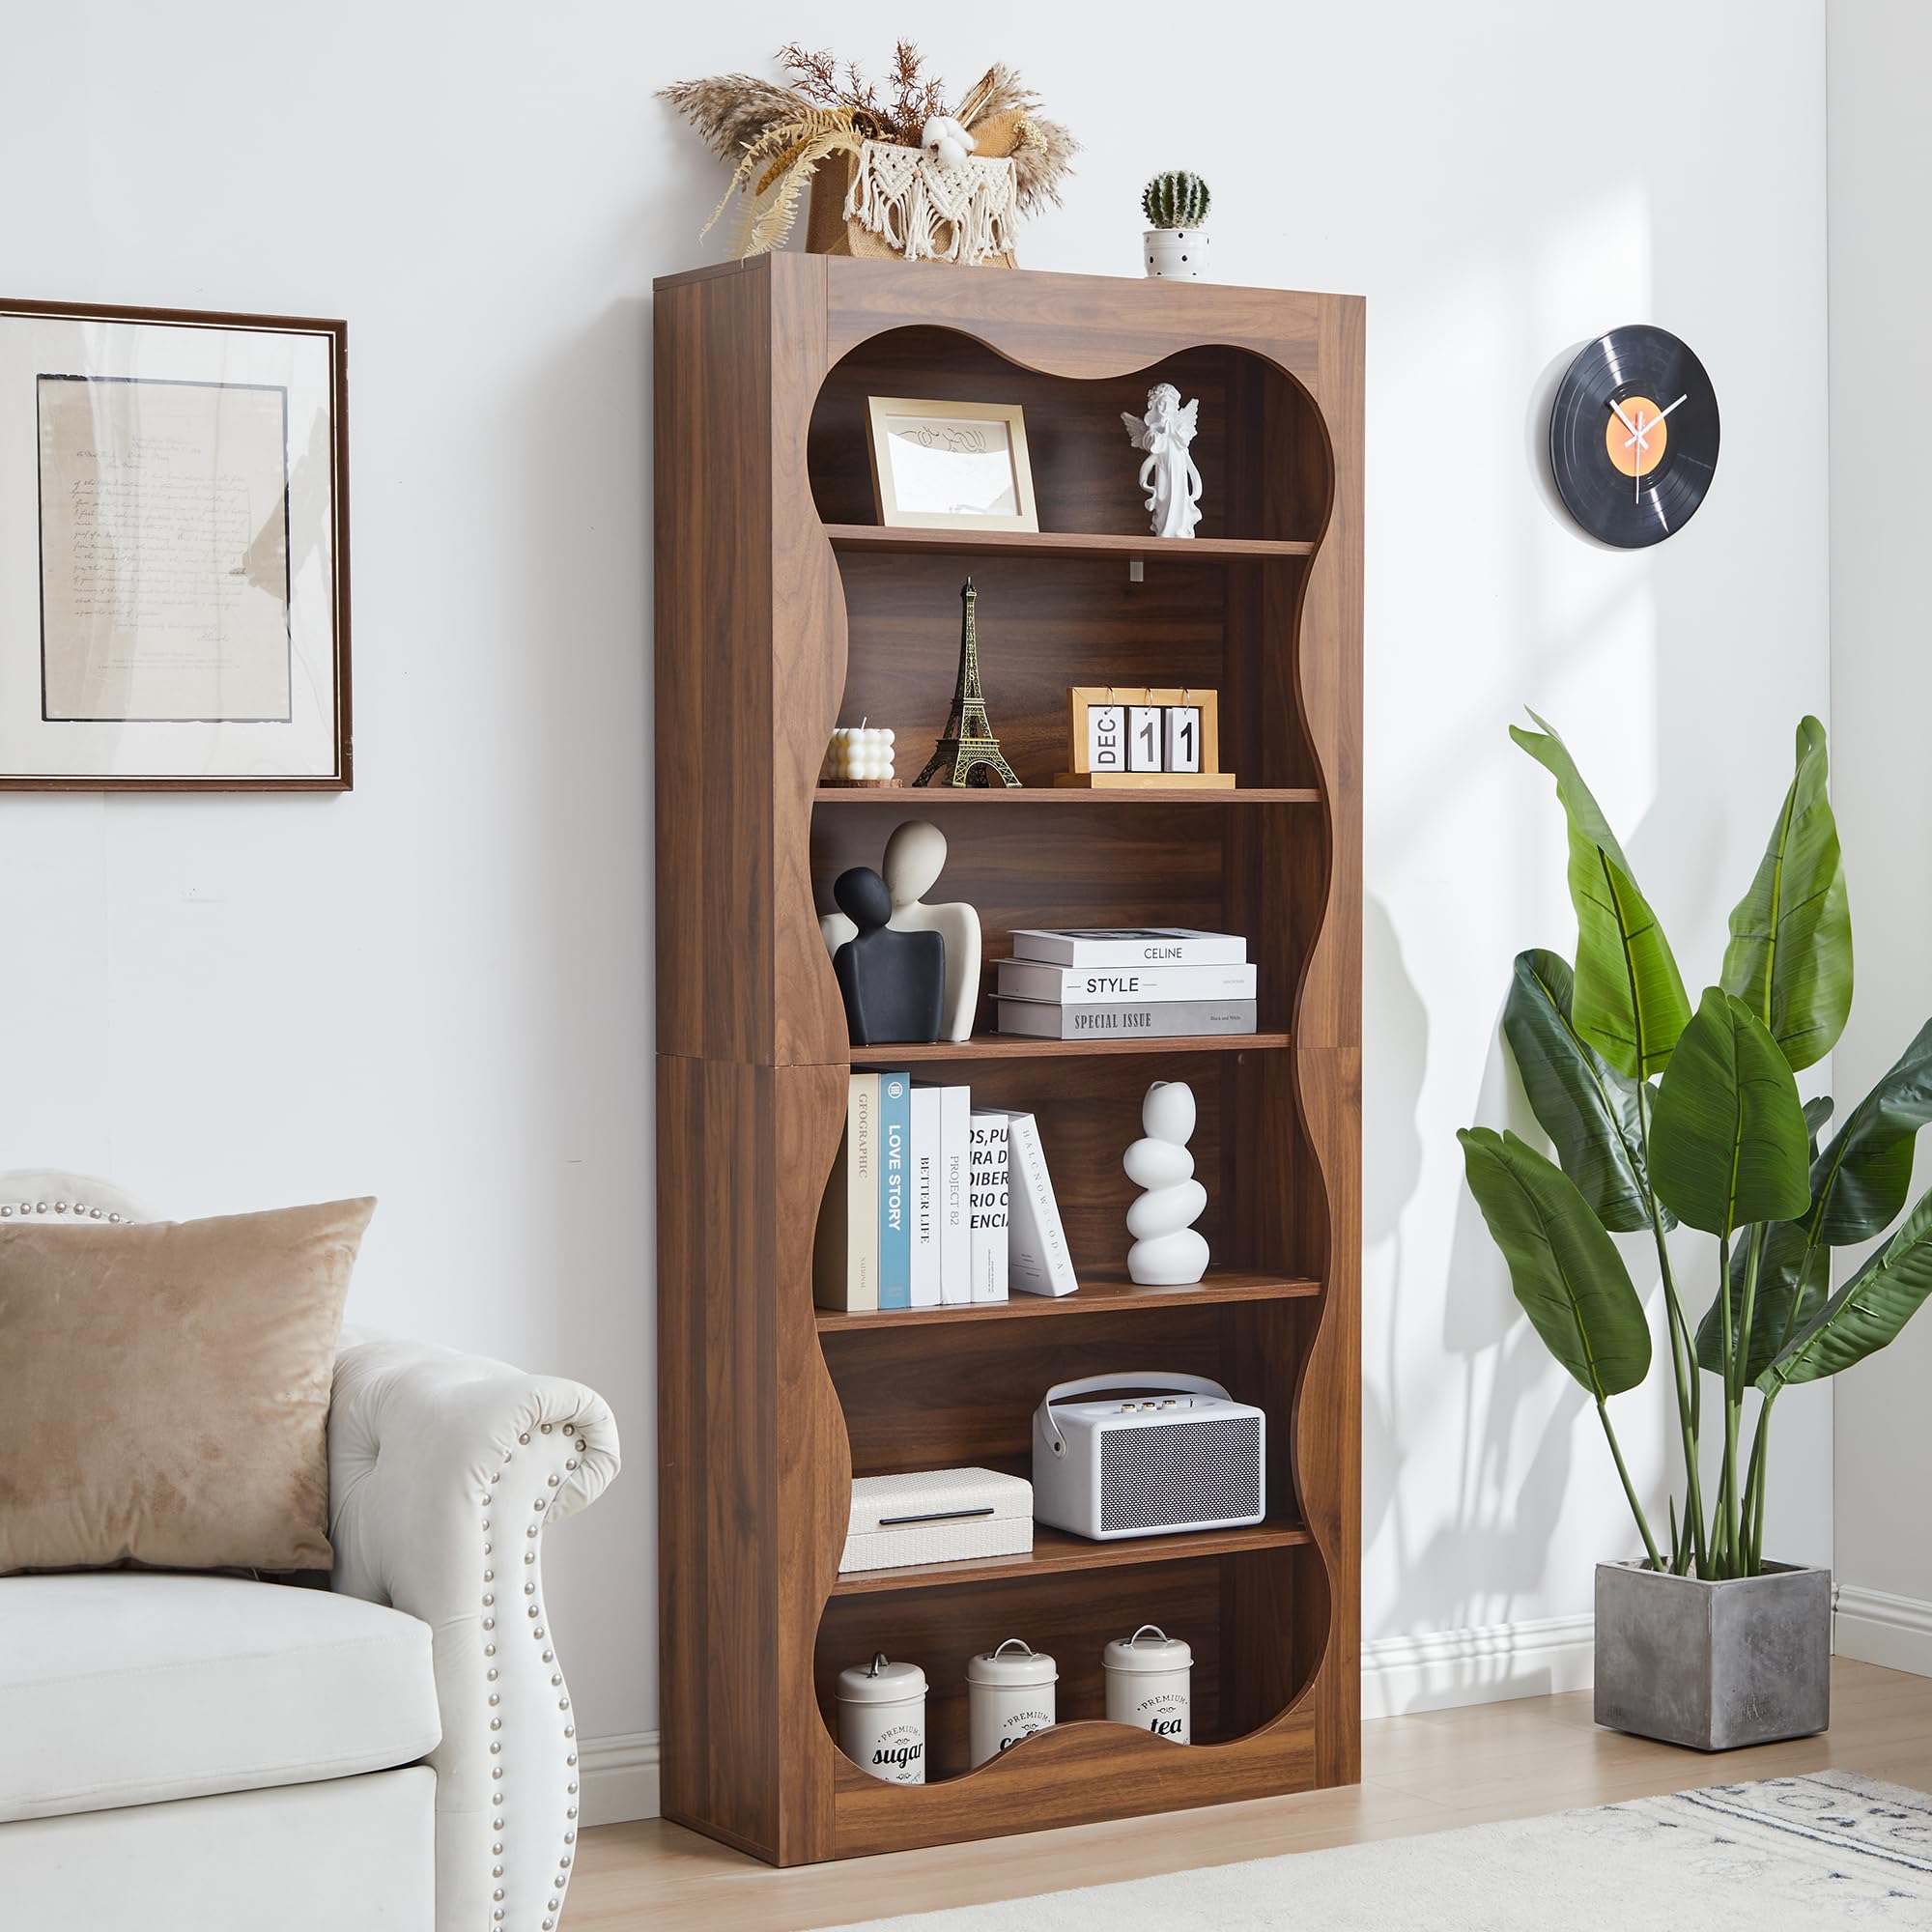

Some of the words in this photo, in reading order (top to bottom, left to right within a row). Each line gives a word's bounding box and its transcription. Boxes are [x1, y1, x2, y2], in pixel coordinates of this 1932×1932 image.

[1097, 719, 1116, 764] DEC
[1140, 722, 1153, 762] 1
[1180, 722, 1192, 762] 1
[1144, 948, 1182, 959] CELINE
[1087, 978, 1139, 993] STYLE
[1074, 1014, 1118, 1030] SPECIAL
[1122, 1013, 1151, 1028] ISSUE
[859, 1094, 867, 1179] GEOGRAPHIC
[889, 1124, 900, 1170] LOVE
[921, 1157, 929, 1209] BETTER
[949, 1155, 959, 1208] PROJECT
[889, 1175, 901, 1232] STORY
[921, 1213, 929, 1244] LIFE
[950, 1210, 959, 1226] 82
[1141, 1694, 1185, 1709] PREMIUM
[1007, 1711, 1049, 1726] PREMIUM
[1151, 1718, 1181, 1735] tea
[881, 1725, 919, 1741] PREMIUM
[872, 1743, 923, 1769] sugar
